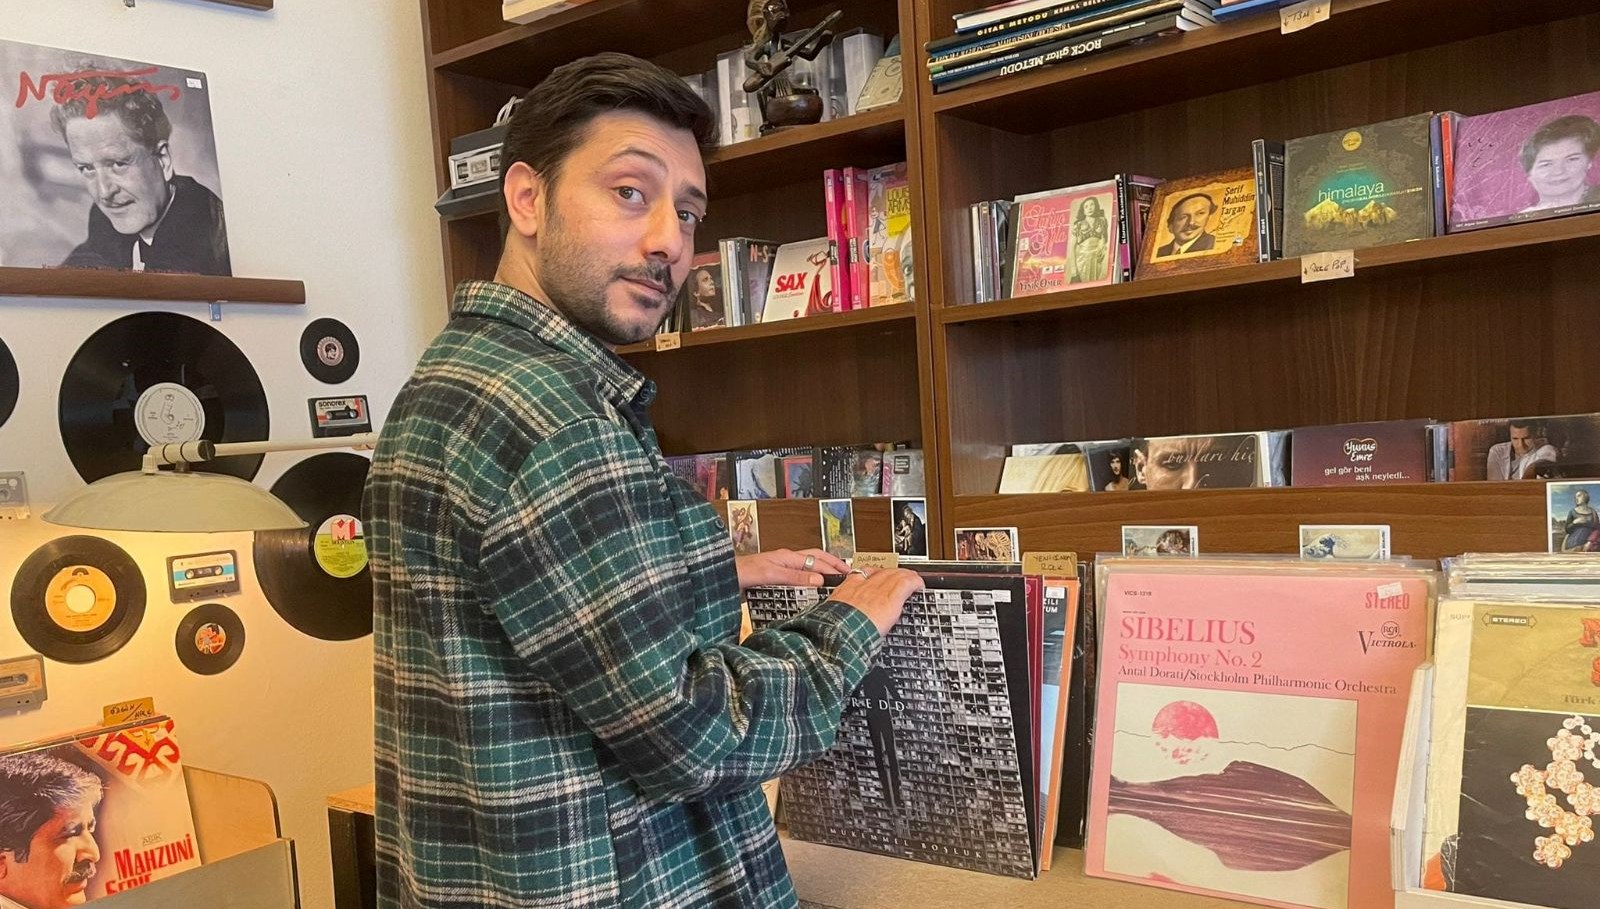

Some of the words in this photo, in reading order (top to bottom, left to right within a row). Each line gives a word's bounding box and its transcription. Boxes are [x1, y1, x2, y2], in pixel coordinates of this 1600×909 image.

[1009, 12, 1048, 28] METODU
[1053, 4, 1080, 15] KEMAL
[1045, 46, 1069, 60] gitar
[1071, 39, 1103, 56] ROCK
[1000, 56, 1044, 76] METODU
[1318, 182, 1385, 202] himalaya
[1221, 205, 1246, 216] Targan
[775, 272, 808, 294] SAX
[318, 400, 347, 408] sonorex
[1344, 441, 1376, 455] Yunus
[1350, 452, 1373, 462] Emre
[1324, 467, 1336, 476] gel
[1338, 466, 1352, 475] gör
[1354, 465, 1372, 473] beni
[1365, 591, 1410, 610] STEREO
[1491, 617, 1527, 625] STEREO
[1120, 616, 1256, 646] SIBELIUS
[1119, 643, 1211, 668] Symphony
[1215, 649, 1247, 667] No.
[1251, 651, 1263, 668] 2
[1118, 665, 1146, 676] Antal
[1253, 673, 1332, 691] Philharmonic
[1335, 679, 1397, 695] Orchestra
[852, 696, 905, 711] REDD
